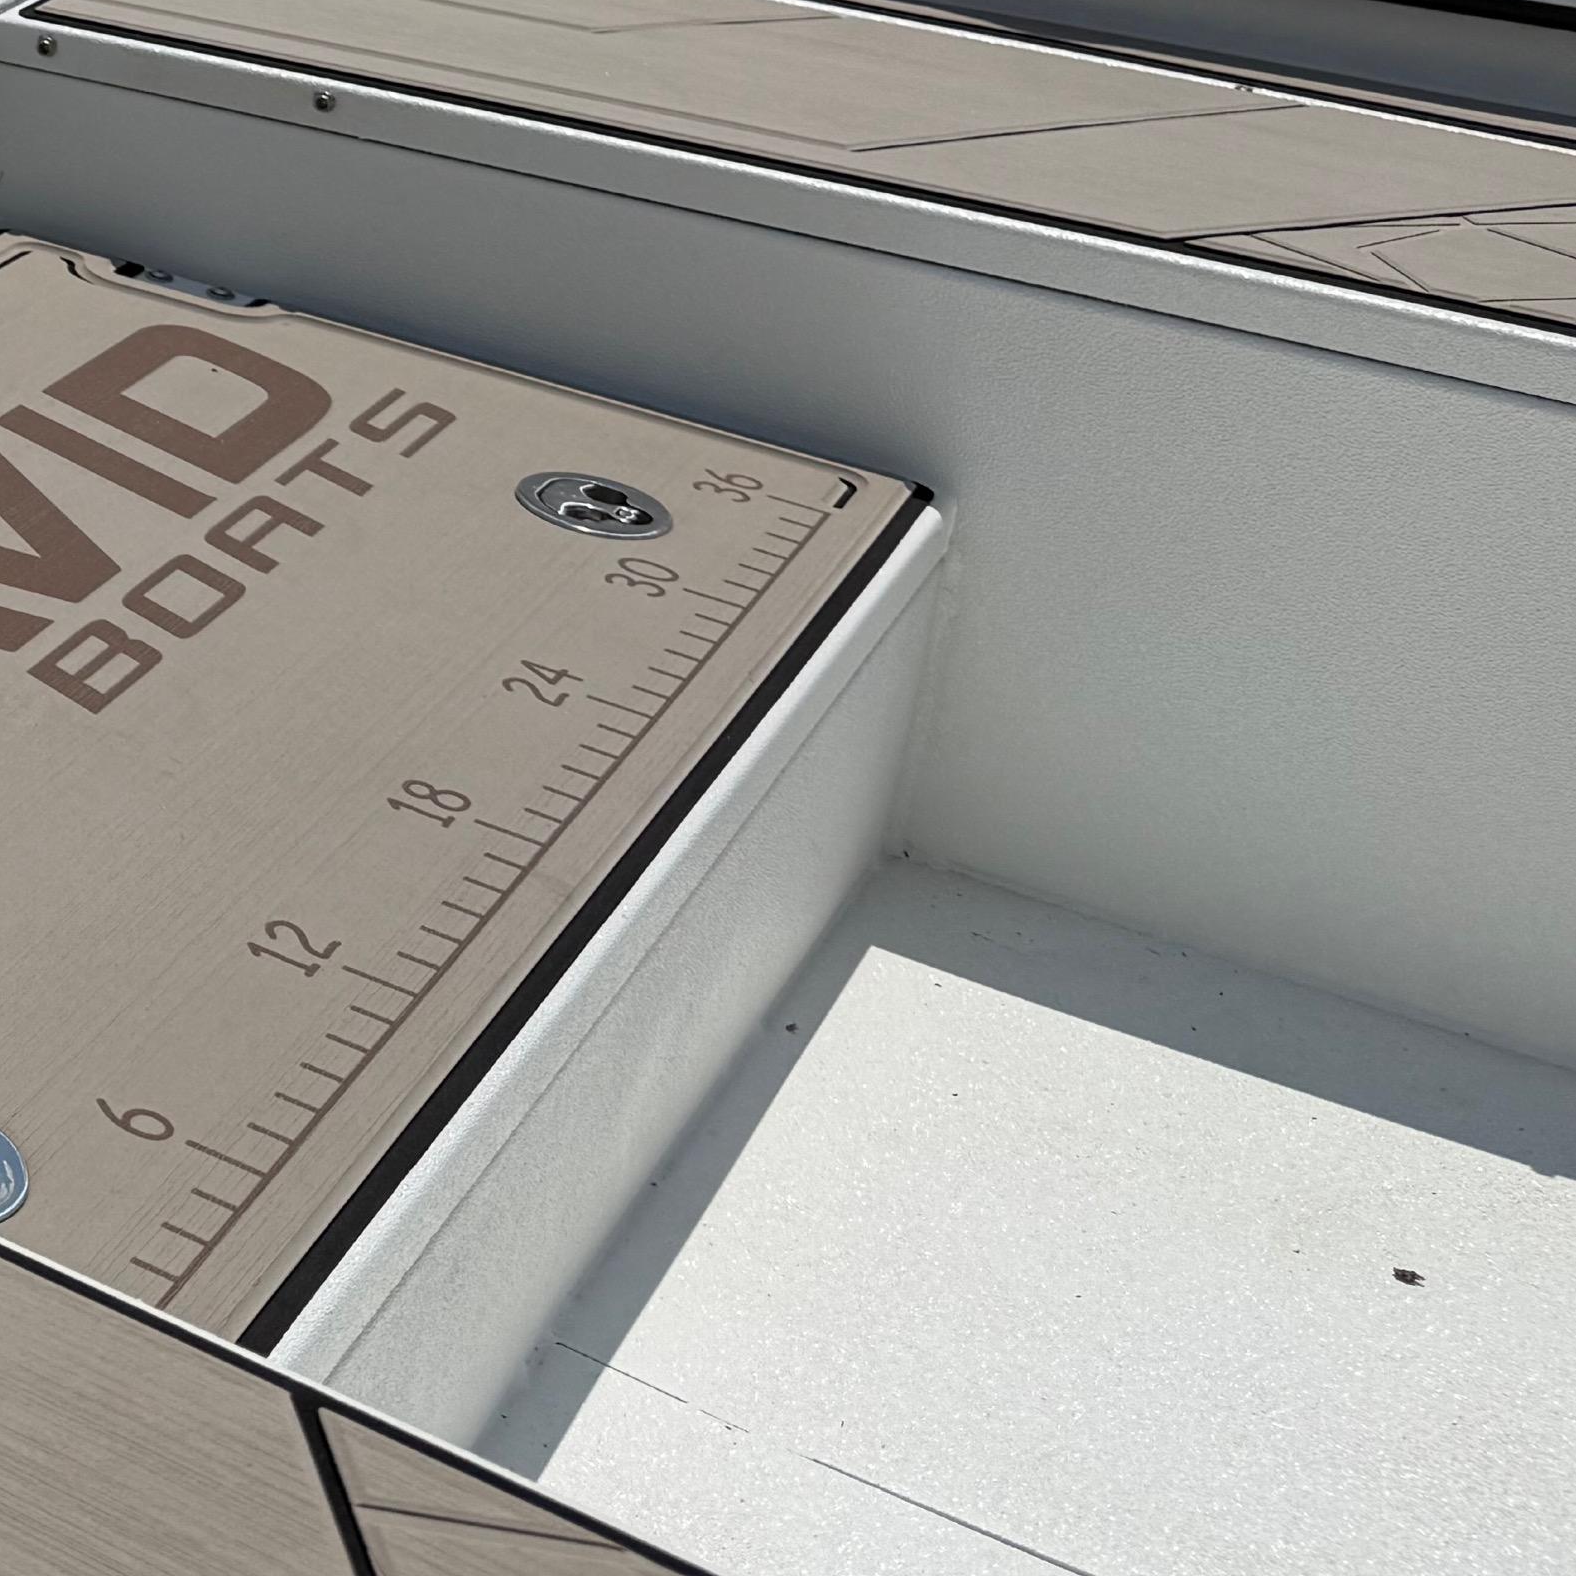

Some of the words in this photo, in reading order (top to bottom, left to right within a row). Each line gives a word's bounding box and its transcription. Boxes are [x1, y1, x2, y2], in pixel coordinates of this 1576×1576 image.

[691, 467, 766, 504] 36
[26, 386, 459, 714] BOATS
[603, 556, 681, 599] 30
[499, 656, 587, 709] 24
[385, 777, 475, 833] 18
[246, 917, 345, 980] 12
[96, 1097, 179, 1144] 6
